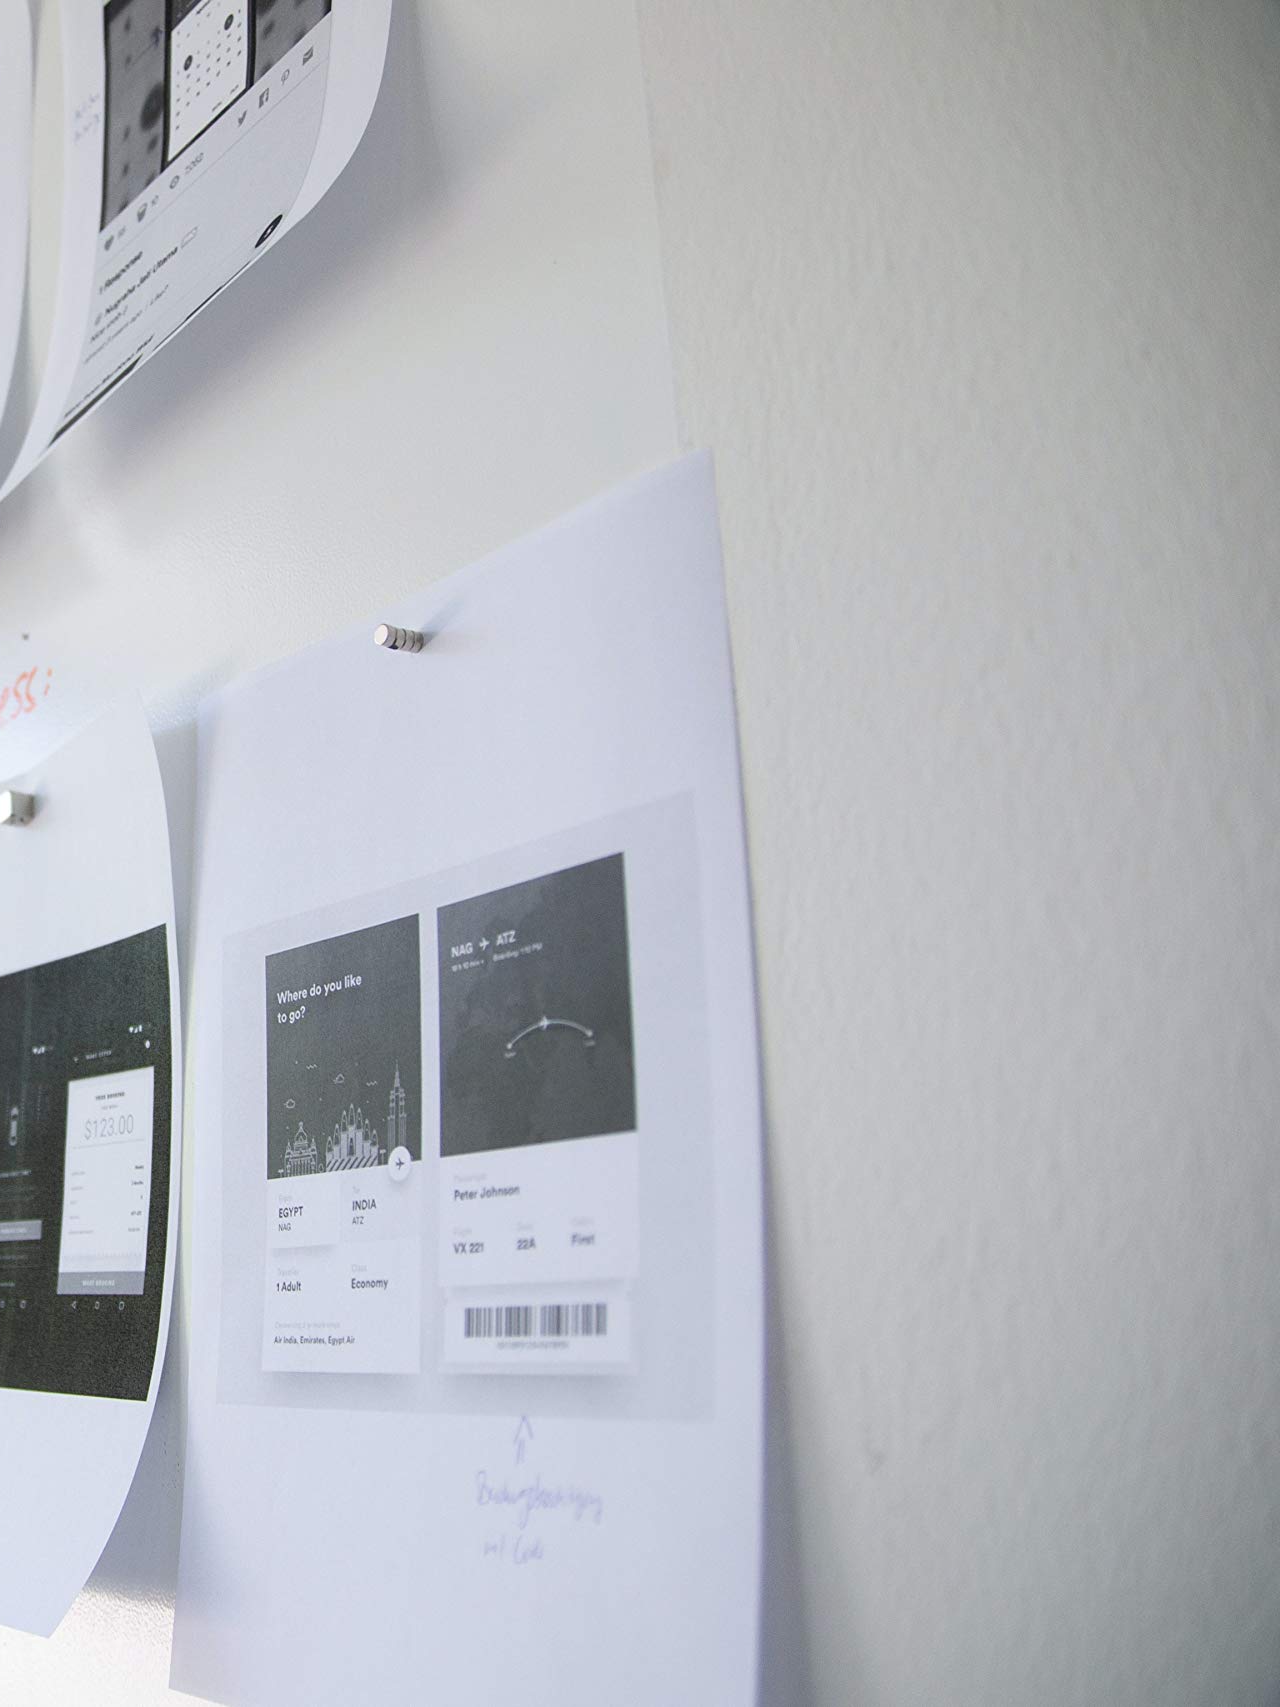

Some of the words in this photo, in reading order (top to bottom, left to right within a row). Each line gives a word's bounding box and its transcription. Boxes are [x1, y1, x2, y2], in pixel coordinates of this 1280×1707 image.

[450, 942, 473, 958] NAG
[495, 929, 516, 946] ATZ
[276, 989, 308, 1005] Where
[309, 983, 322, 997] do
[323, 980, 342, 997] you
[344, 974, 362, 989] like
[277, 1012, 287, 1024] to
[288, 1005, 306, 1024] go?
[84, 1114, 134, 1140] $123.00
[454, 1189, 478, 1201] Peter
[480, 1185, 520, 1199] Johnson
[352, 1198, 377, 1211] INDIA
[278, 1206, 304, 1218] EGYPT
[352, 1216, 364, 1225] ATZ
[278, 1223, 292, 1232] NAG
[516, 1237, 536, 1250] 22A
[571, 1233, 595, 1246] First
[453, 1243, 467, 1254] VX
[469, 1242, 484, 1254] 221
[276, 1282, 280, 1292] 1
[281, 1281, 302, 1292] Adult
[351, 1278, 389, 1291] Economy
[274, 1336, 282, 1344] Air
[283, 1336, 298, 1345] India,
[300, 1336, 326, 1345] Emirates,
[328, 1336, 345, 1346] Egypt
[346, 1336, 355, 1344] Air
